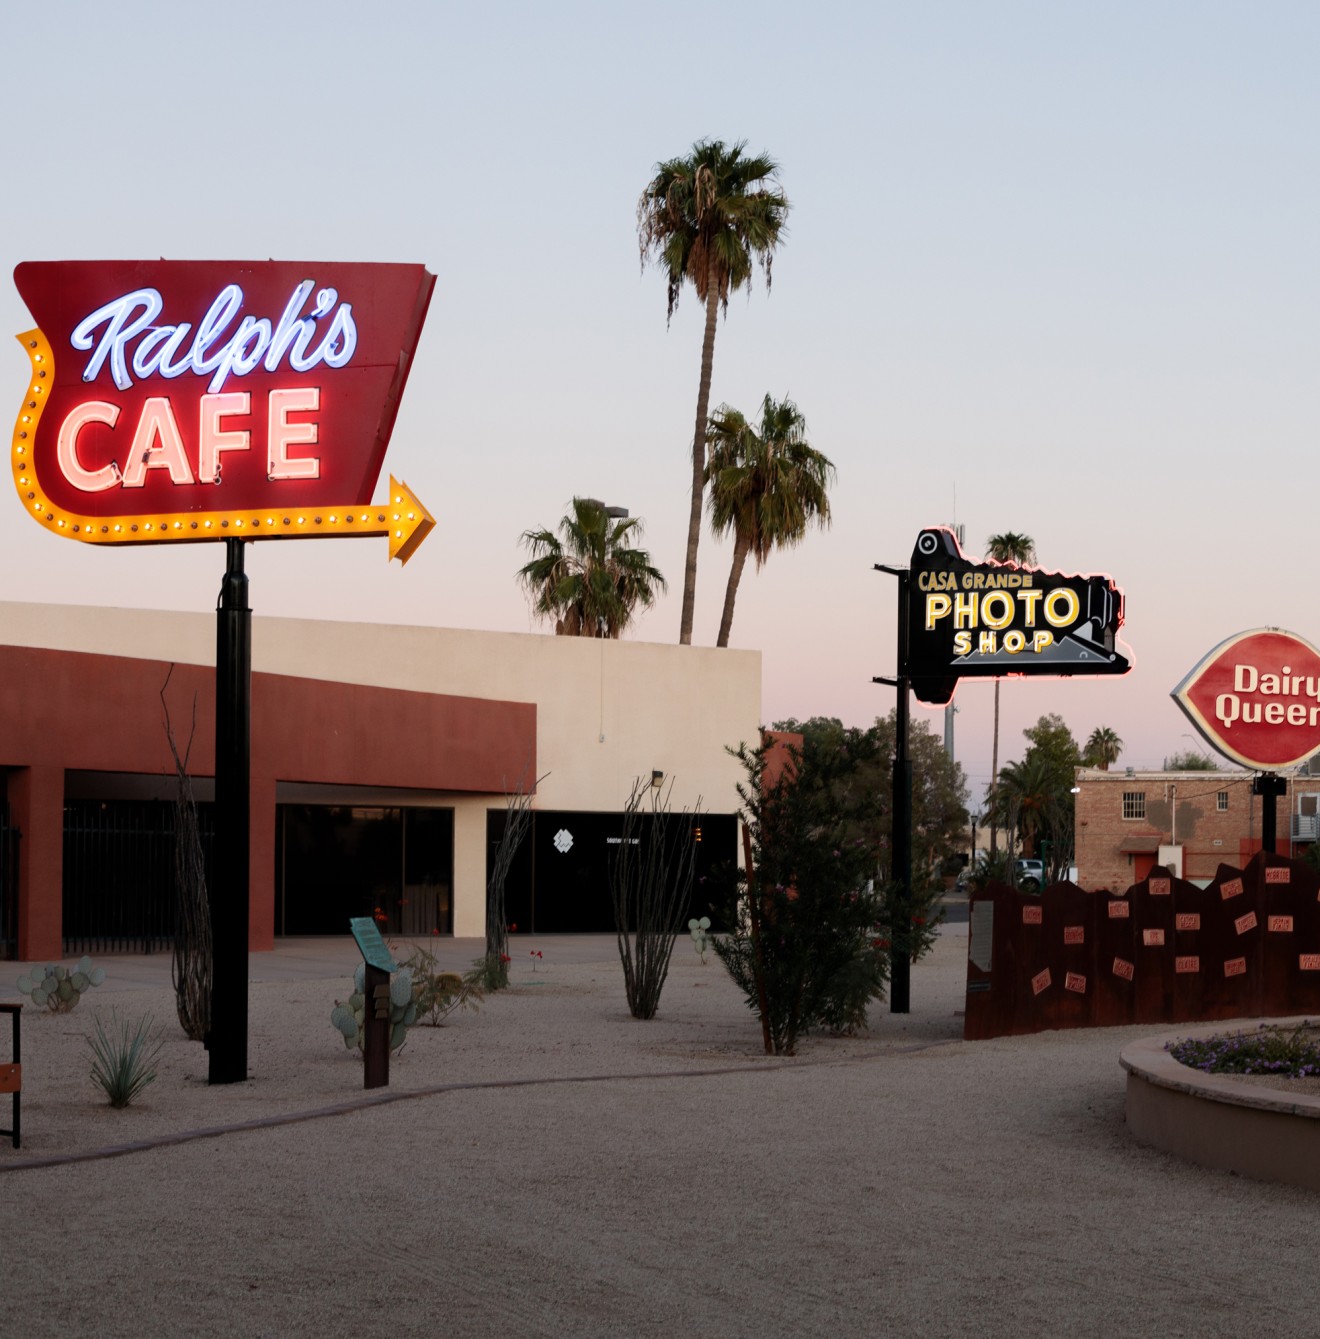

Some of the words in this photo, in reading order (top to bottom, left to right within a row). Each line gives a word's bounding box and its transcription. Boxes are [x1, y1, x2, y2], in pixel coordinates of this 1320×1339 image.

[70, 278, 358, 394] Ralph's
[56, 386, 321, 493] CAFE
[918, 571, 957, 591] CASA
[962, 572, 1033, 590] GRANDE
[925, 587, 1080, 631] PHOTO
[953, 630, 1054, 655] SHOP
